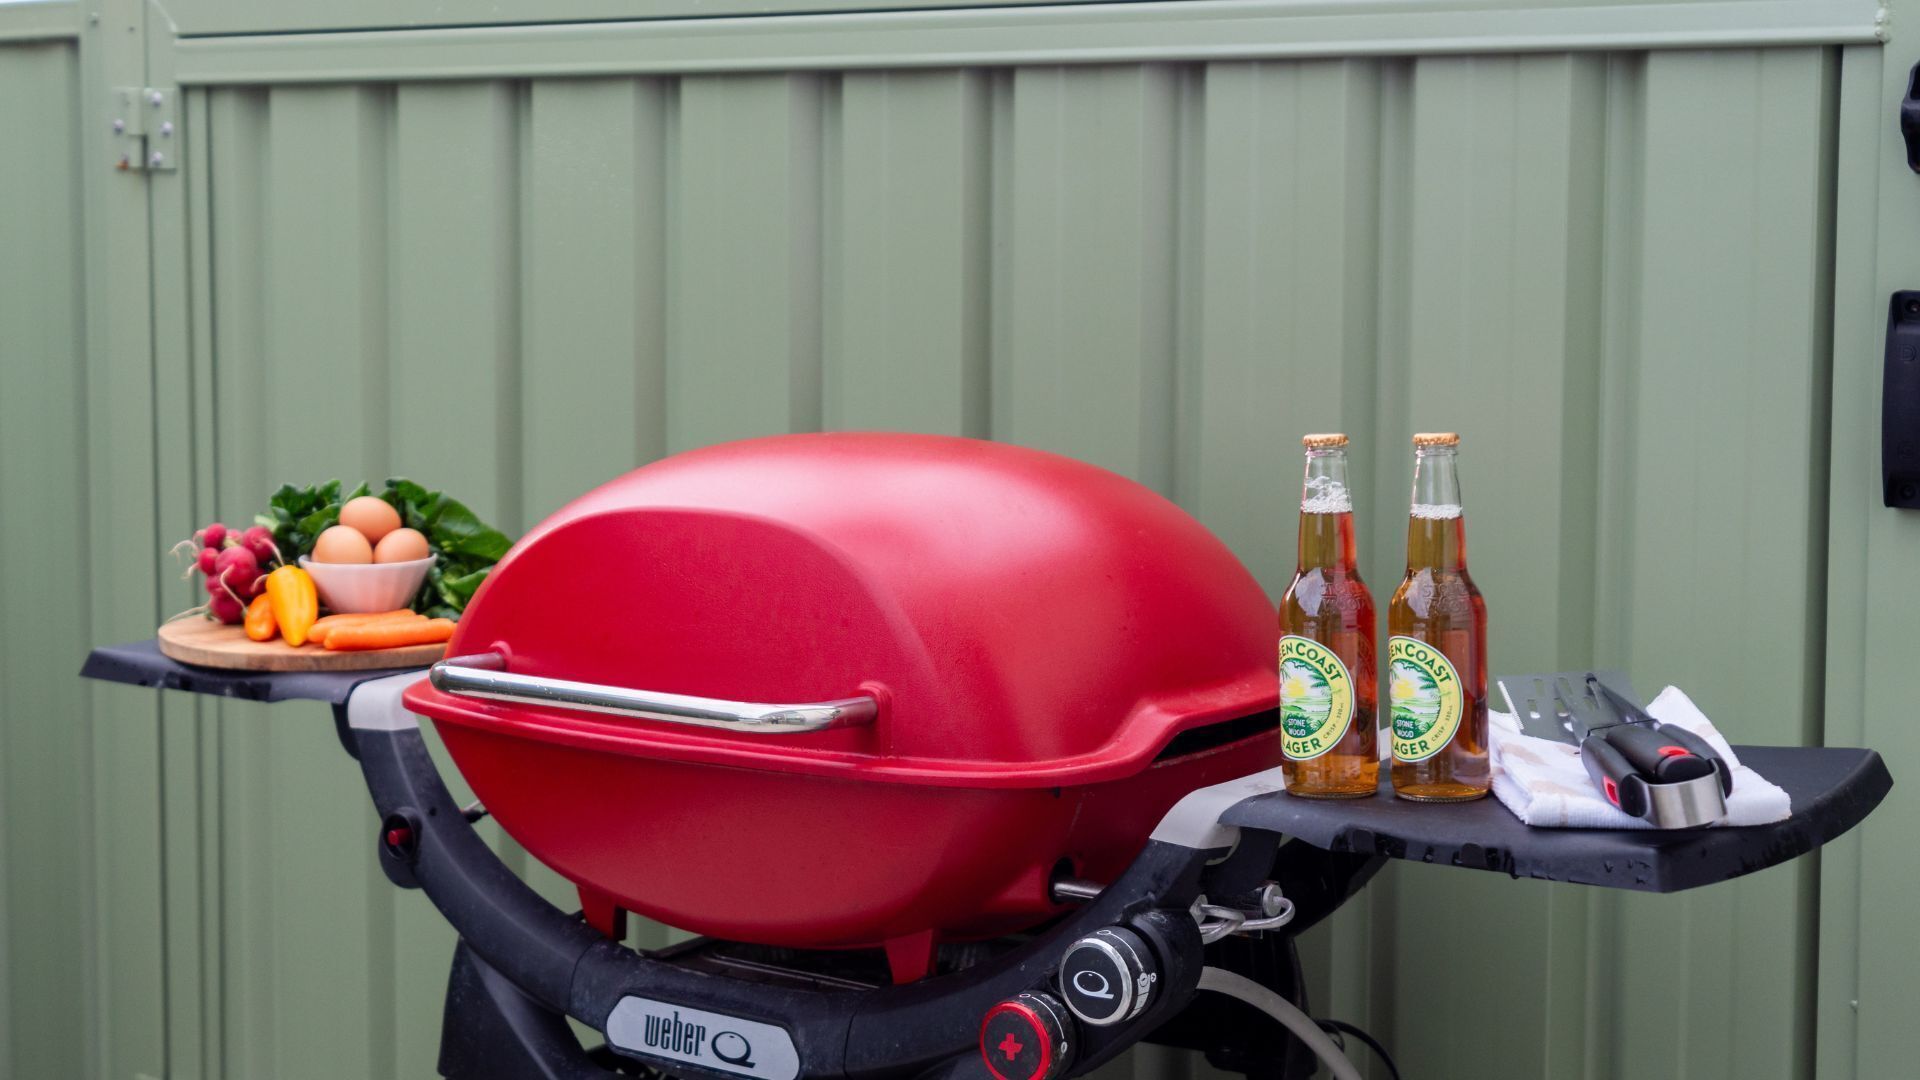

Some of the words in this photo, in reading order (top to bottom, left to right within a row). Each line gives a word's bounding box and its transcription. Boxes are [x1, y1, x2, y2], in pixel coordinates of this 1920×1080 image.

[1280, 643, 1293, 660] EN
[1295, 642, 1342, 681] COAST
[1405, 643, 1452, 682] COAST
[1288, 718, 1306, 727] STONE
[1396, 719, 1414, 729] STONE
[1288, 727, 1306, 737] WOOD
[1323, 723, 1337, 739] CRISP
[1397, 728, 1414, 738] WOOD
[645, 1010, 707, 1057] weber
